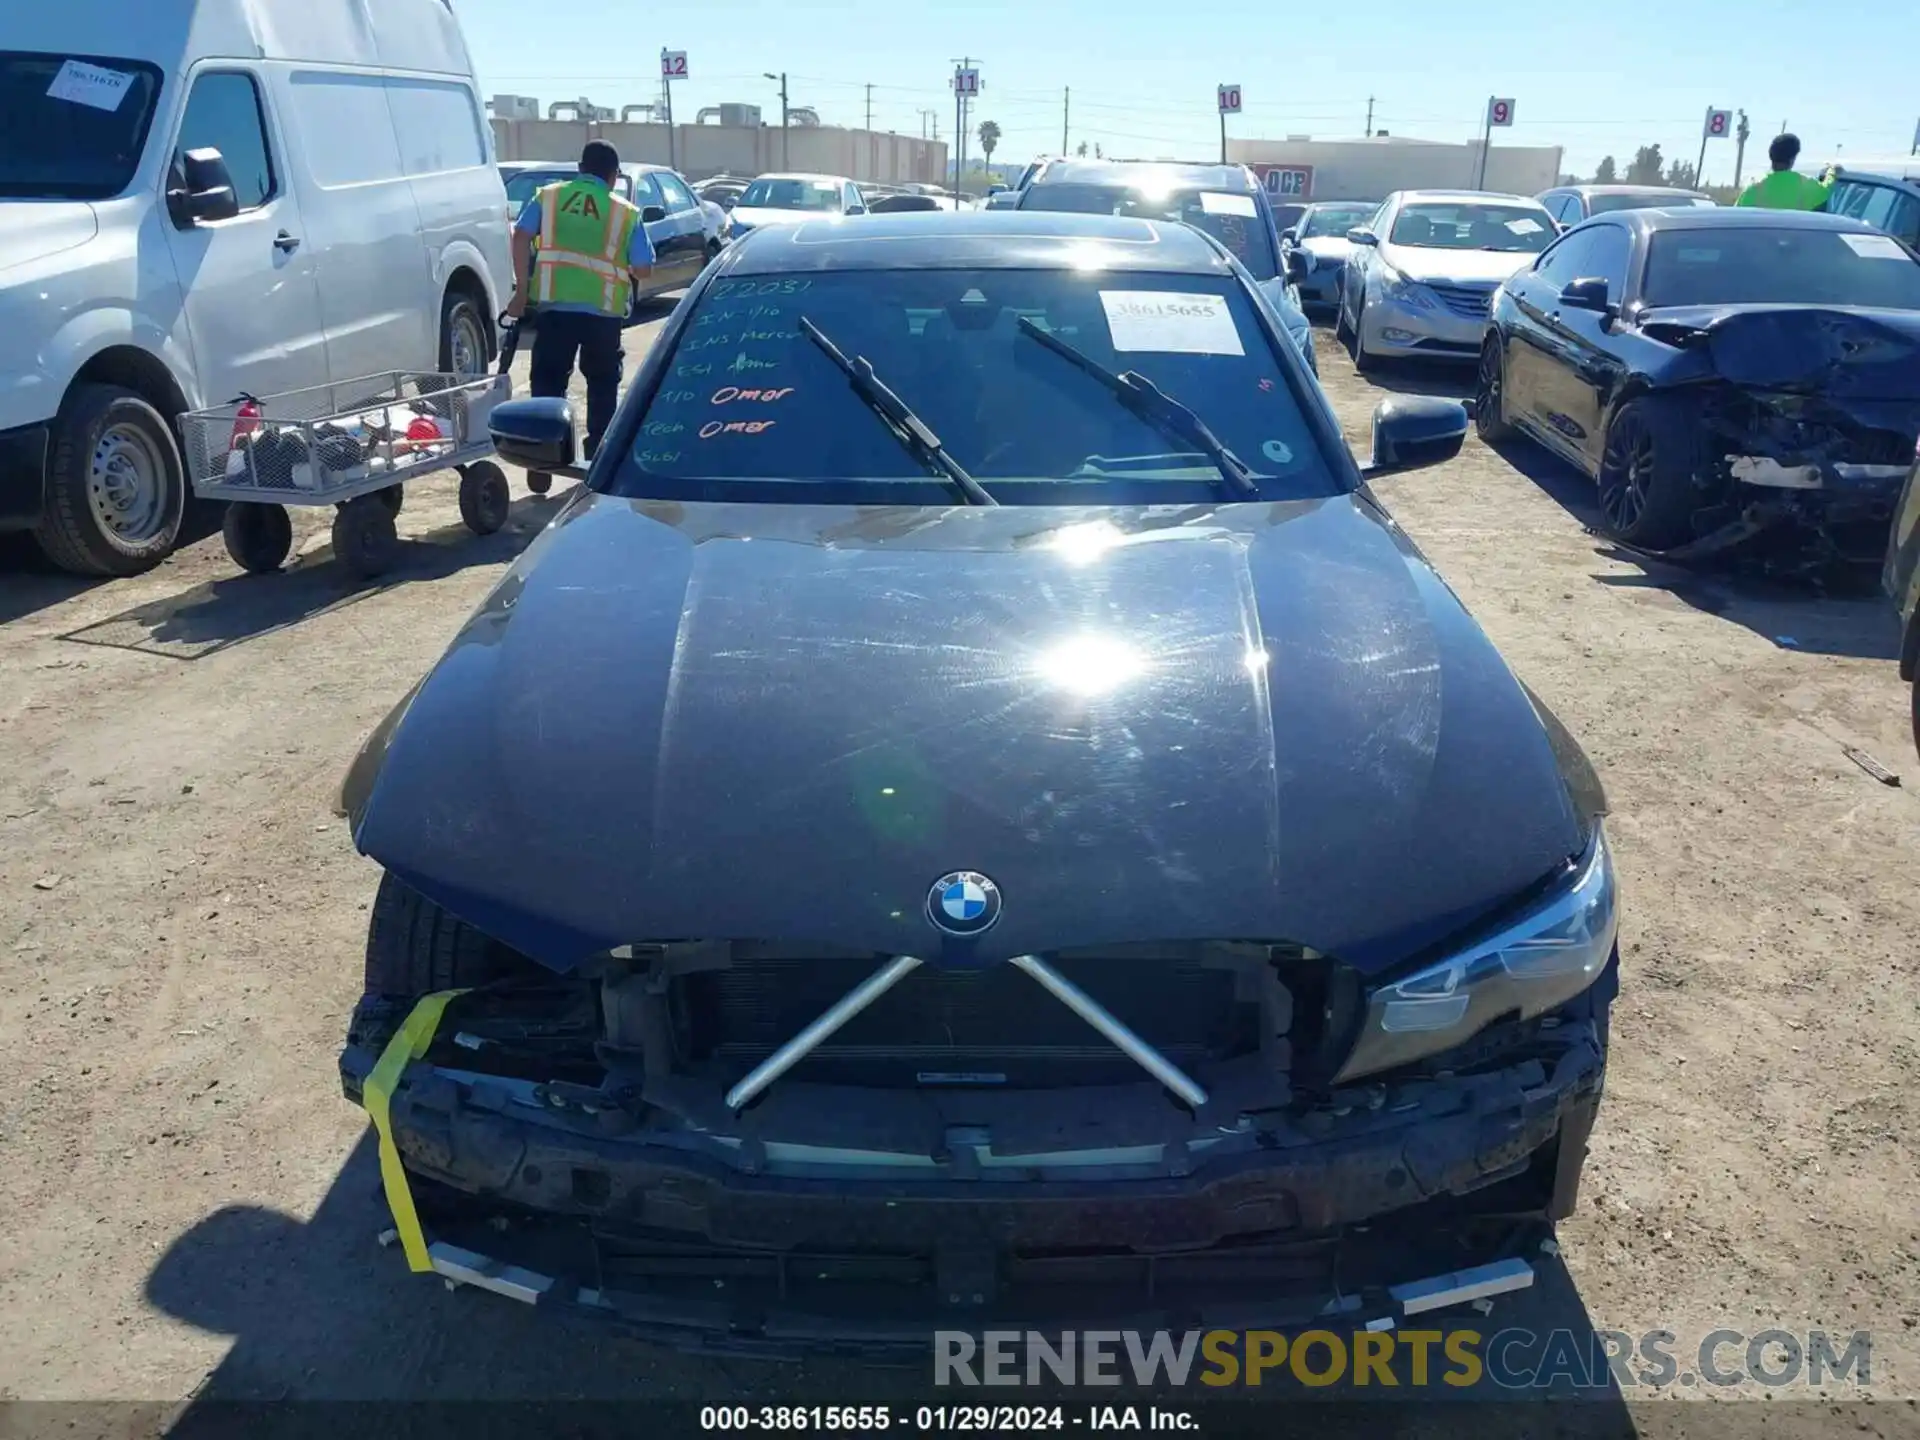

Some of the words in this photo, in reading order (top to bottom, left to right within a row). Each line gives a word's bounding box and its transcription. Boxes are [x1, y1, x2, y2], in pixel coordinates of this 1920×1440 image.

[663, 56, 687, 75] 12
[955, 74, 977, 93] 11
[1219, 90, 1240, 110] 10
[1494, 102, 1508, 123] 9
[1710, 112, 1725, 135] 8
[1116, 303, 1216, 319] 38615655
[935, 871, 995, 892] BMW
